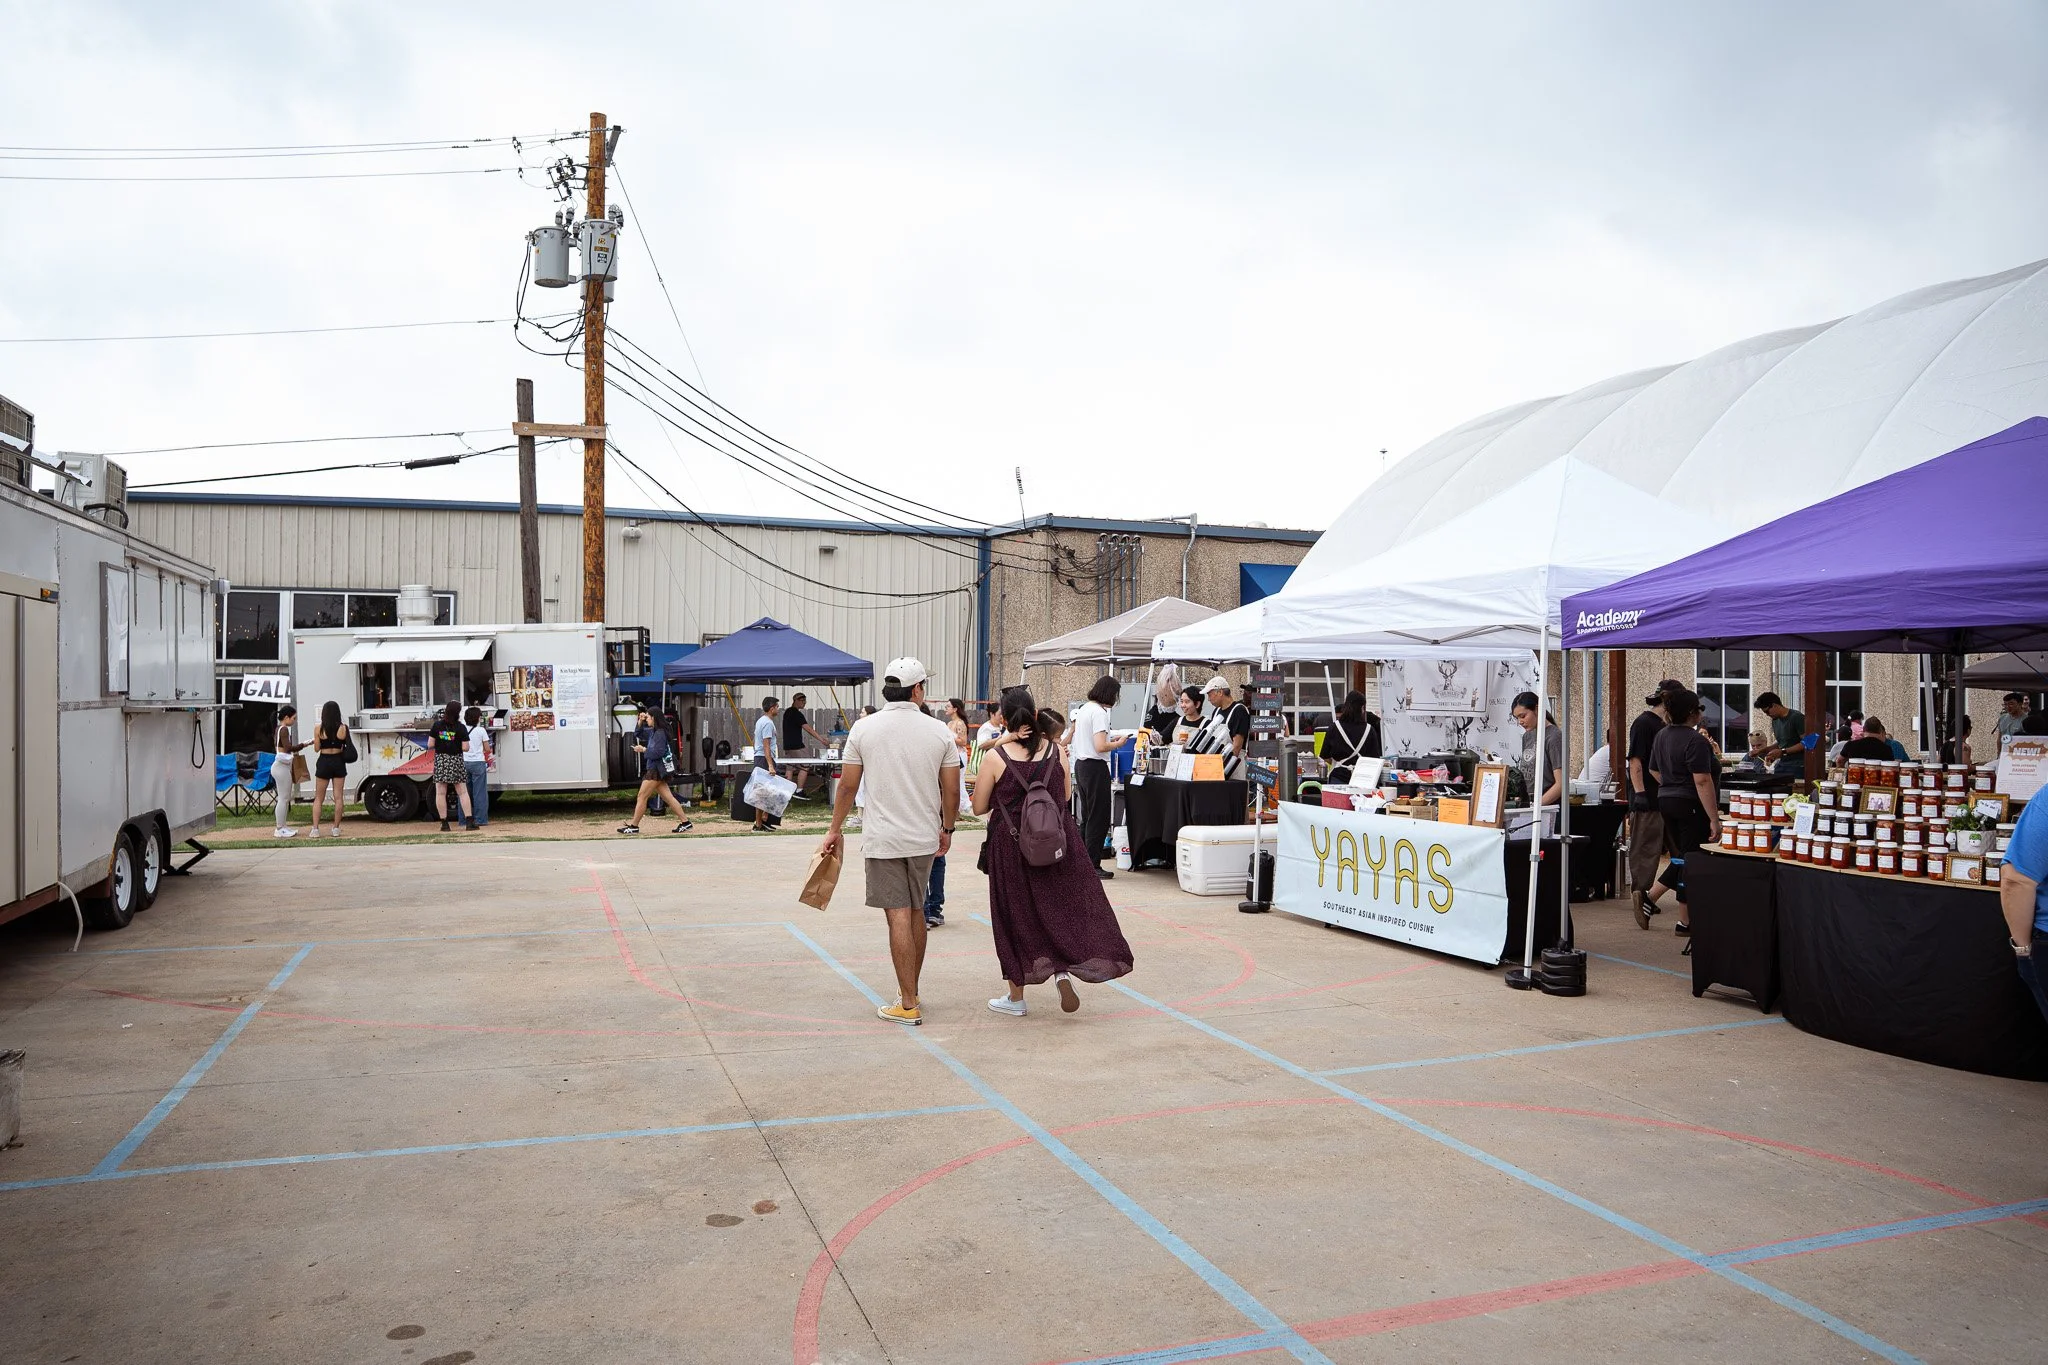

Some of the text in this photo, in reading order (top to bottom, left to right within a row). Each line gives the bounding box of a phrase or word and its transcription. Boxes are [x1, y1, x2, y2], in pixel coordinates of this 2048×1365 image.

[1576, 608, 1642, 628] Academy
[2013, 747, 2041, 757] NEW!
[1310, 824, 1454, 914] YAYAS
[1323, 901, 1435, 935] SOUTHEAST ASIAN INSPIRED CUISINE
